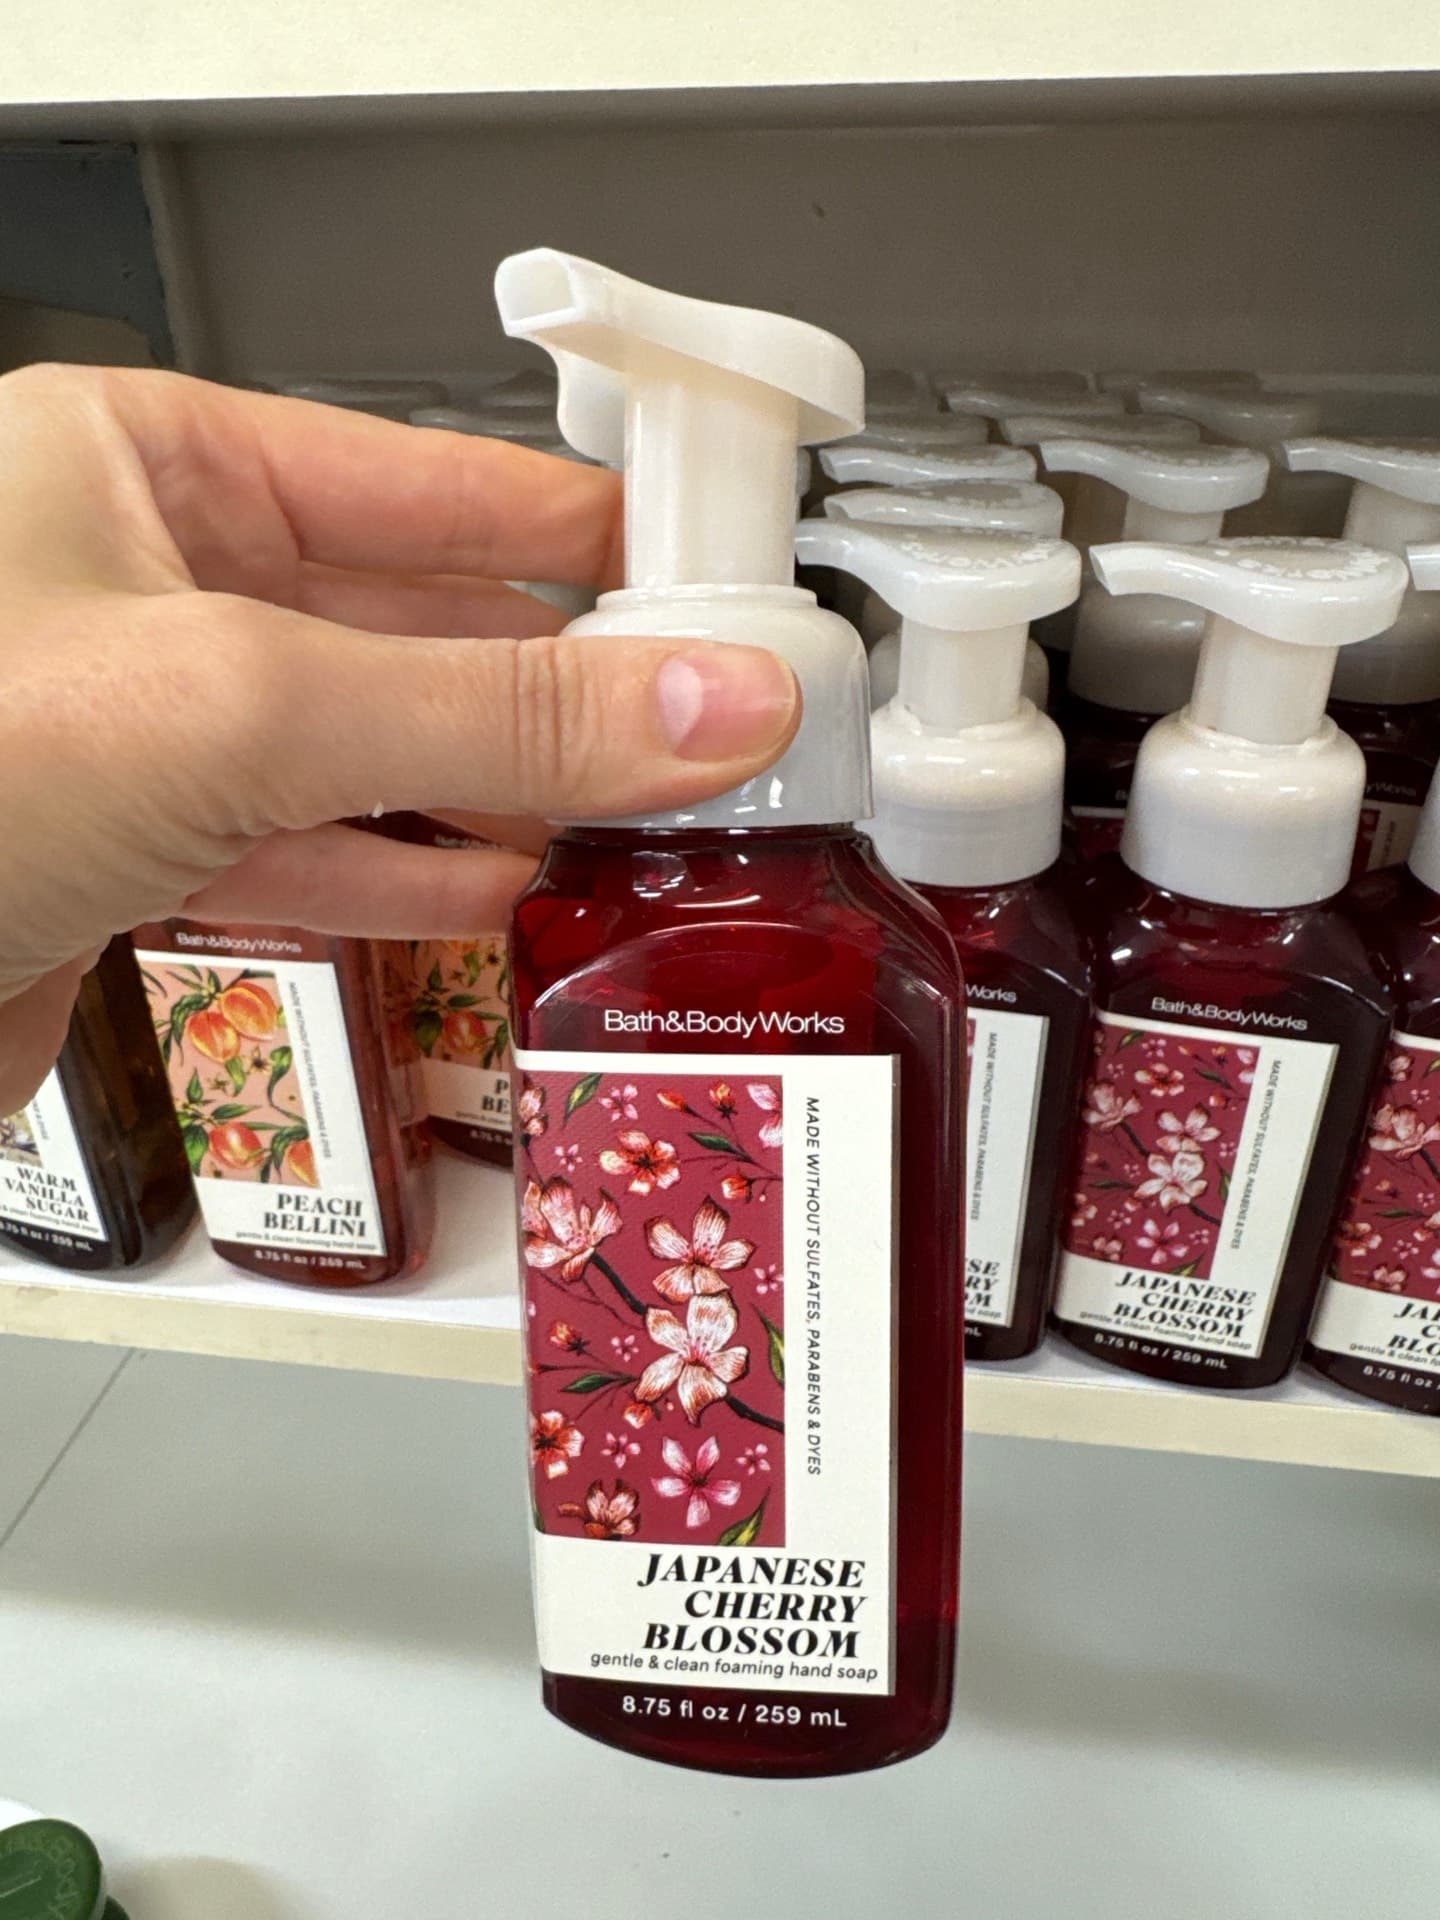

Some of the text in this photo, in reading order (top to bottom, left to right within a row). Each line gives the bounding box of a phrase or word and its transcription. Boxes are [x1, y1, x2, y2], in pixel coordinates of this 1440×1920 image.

[4, 1178, 86, 1209] VANILLA
[17, 1166, 77, 1193] WARM
[26, 1196, 90, 1223] SUGAR
[277, 1193, 363, 1217] PEACH
[264, 1212, 367, 1238] BELLINI
[805, 1096, 822, 1476] MADE WITHOUT SULFATES, PARABENS & DYES
[1115, 1271, 1257, 1306] JAPANESE
[1079, 1311, 1113, 1324] gentle
[1113, 1303, 1244, 1338] BLOSSOM
[1141, 1292, 1253, 1321] CHERRY
[1094, 1332, 1124, 1349] 8.75
[1172, 1350, 1201, 1365] 259
[1205, 1357, 1228, 1370] mL
[1363, 1365, 1396, 1380] 8.75
[636, 1553, 866, 1588] JAPANESE
[684, 1589, 869, 1623] CHERRY
[642, 1622, 862, 1659] BLOSSOM
[590, 1652, 878, 1683] gentle & clean foaming hand soap
[622, 1695, 848, 1727] 8.75 fl oz / 259 mL
